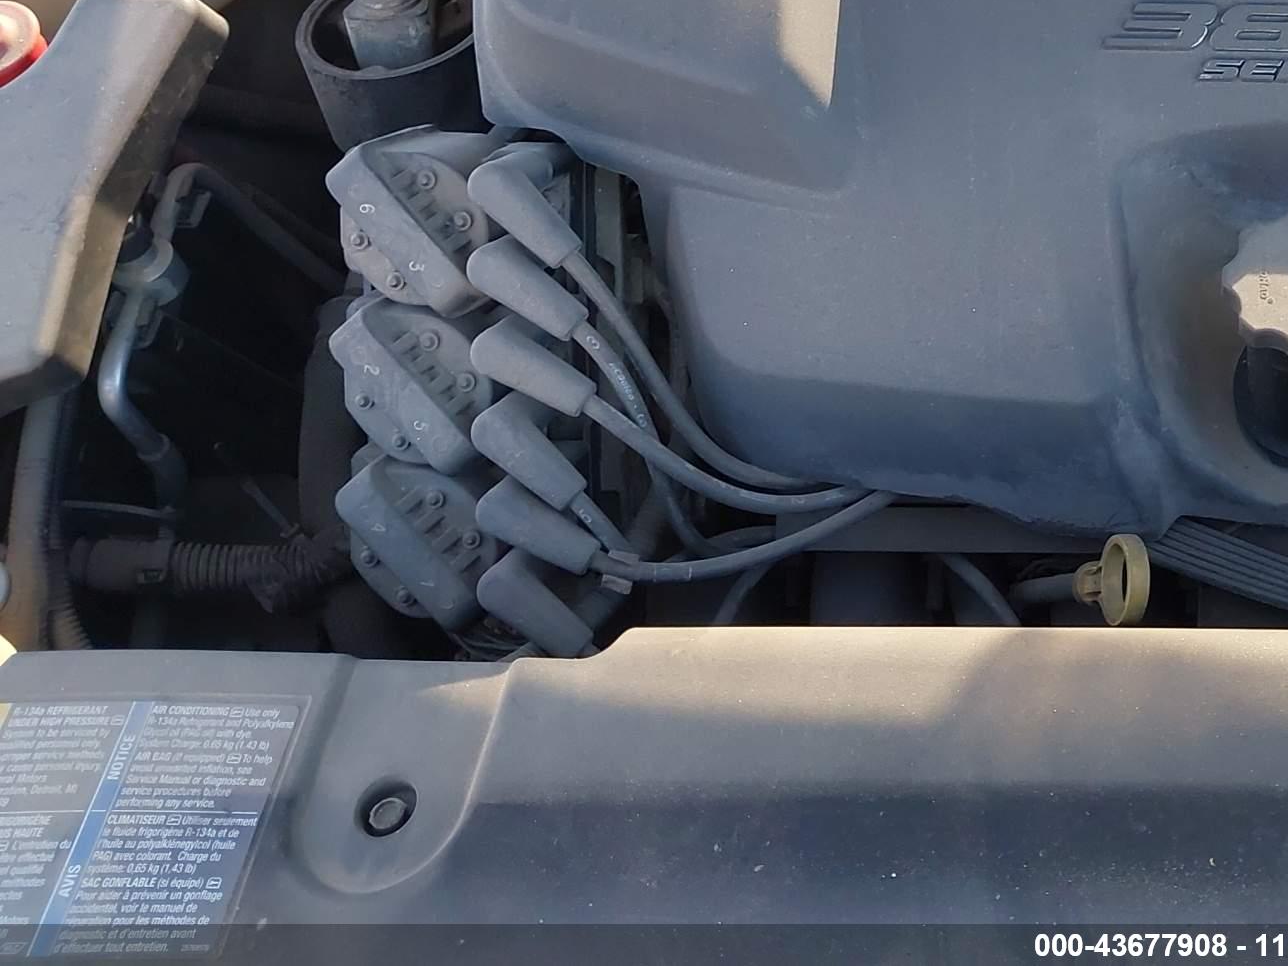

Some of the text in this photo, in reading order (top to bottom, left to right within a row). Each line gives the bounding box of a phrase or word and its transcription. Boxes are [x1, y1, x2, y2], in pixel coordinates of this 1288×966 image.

[364, 364, 380, 375] 2
[152, 705, 167, 715] AIR
[168, 707, 229, 716] CONDITIONING
[107, 734, 136, 780] NOTICE
[107, 815, 165, 825] CLIMATISEUR
[228, 829, 239, 838] de
[177, 852, 208, 863] Charge
[210, 852, 222, 862] du
[147, 864, 160, 874] kg
[59, 864, 81, 897] AVIS
[81, 877, 102, 888] SAC
[102, 878, 156, 888] GONFLABLE
[169, 892, 182, 900] un
[186, 904, 198, 913] de
[197, 915, 210, 925] de
